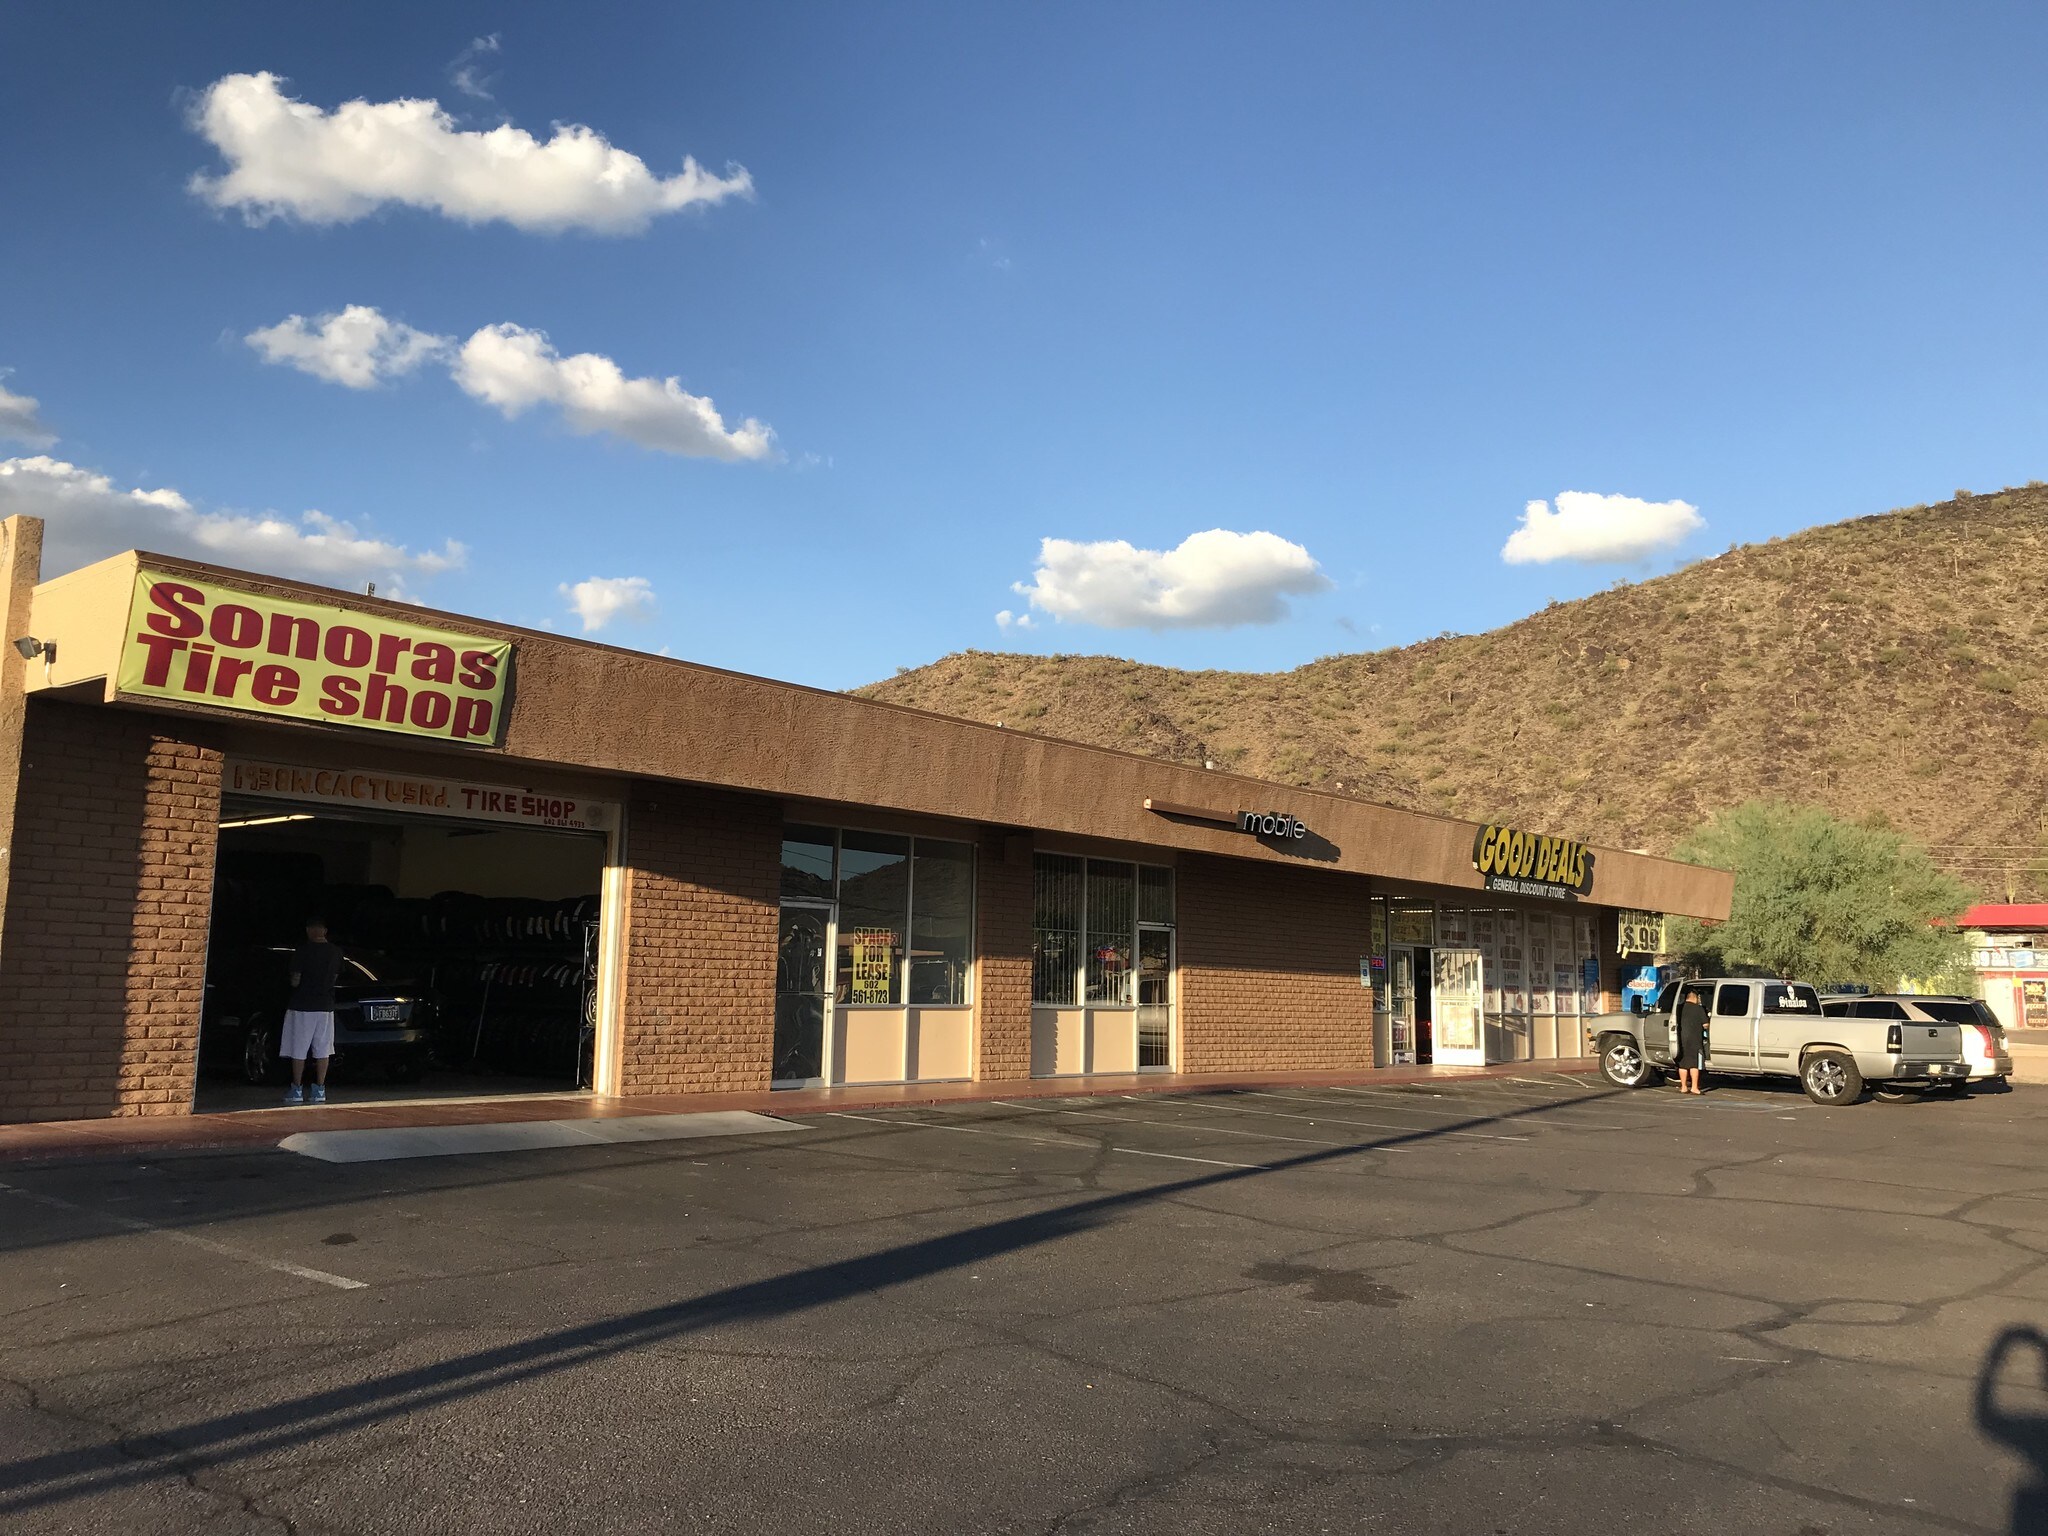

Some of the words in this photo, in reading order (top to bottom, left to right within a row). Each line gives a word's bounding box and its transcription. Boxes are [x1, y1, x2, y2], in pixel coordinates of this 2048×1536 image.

[146, 582, 498, 691] Sonoras
[136, 632, 301, 706] Tire
[318, 672, 493, 738] shop
[460, 787, 517, 814] TIRE
[521, 796, 576, 819] SHOP
[1242, 811, 1306, 839] mobile
[1479, 825, 1536, 878] GOOD
[1536, 836, 1588, 888] DEALS
[1492, 877, 1519, 893] GENERAL
[1519, 882, 1549, 898] DISCOUNT
[1548, 886, 1566, 900] STORE
[854, 927, 891, 945] SPACE
[1623, 924, 1660, 952] $.99
[862, 945, 884, 963] FOR
[855, 963, 888, 981] LEASE
[852, 989, 888, 1004] 561-8723
[863, 981, 879, 989] 602
[1778, 996, 1808, 1008] Sinaloa
